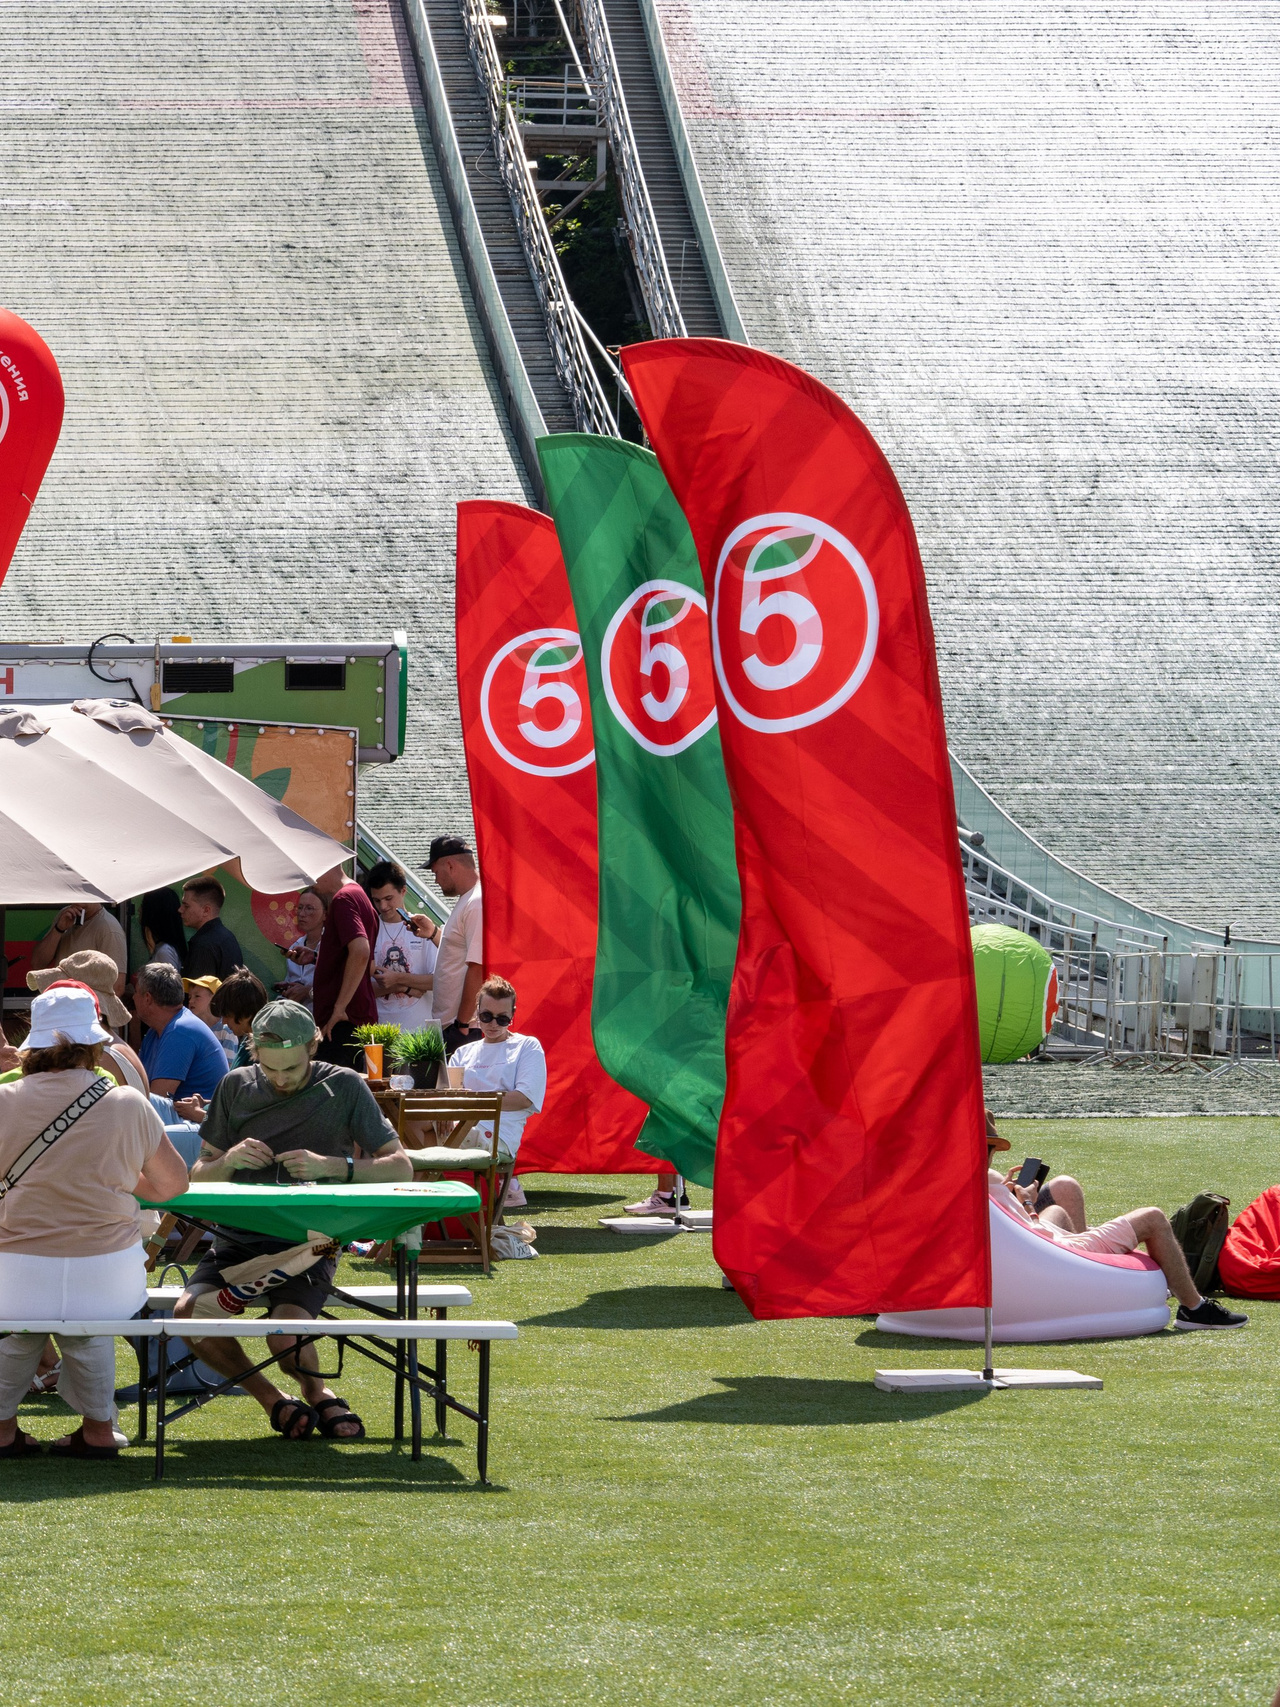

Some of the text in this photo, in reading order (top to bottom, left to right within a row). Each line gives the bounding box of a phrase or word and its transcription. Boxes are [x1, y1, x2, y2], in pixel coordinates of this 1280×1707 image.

[640, 591, 690, 722] 5
[739, 527, 824, 691] 5
[517, 640, 583, 748] 5
